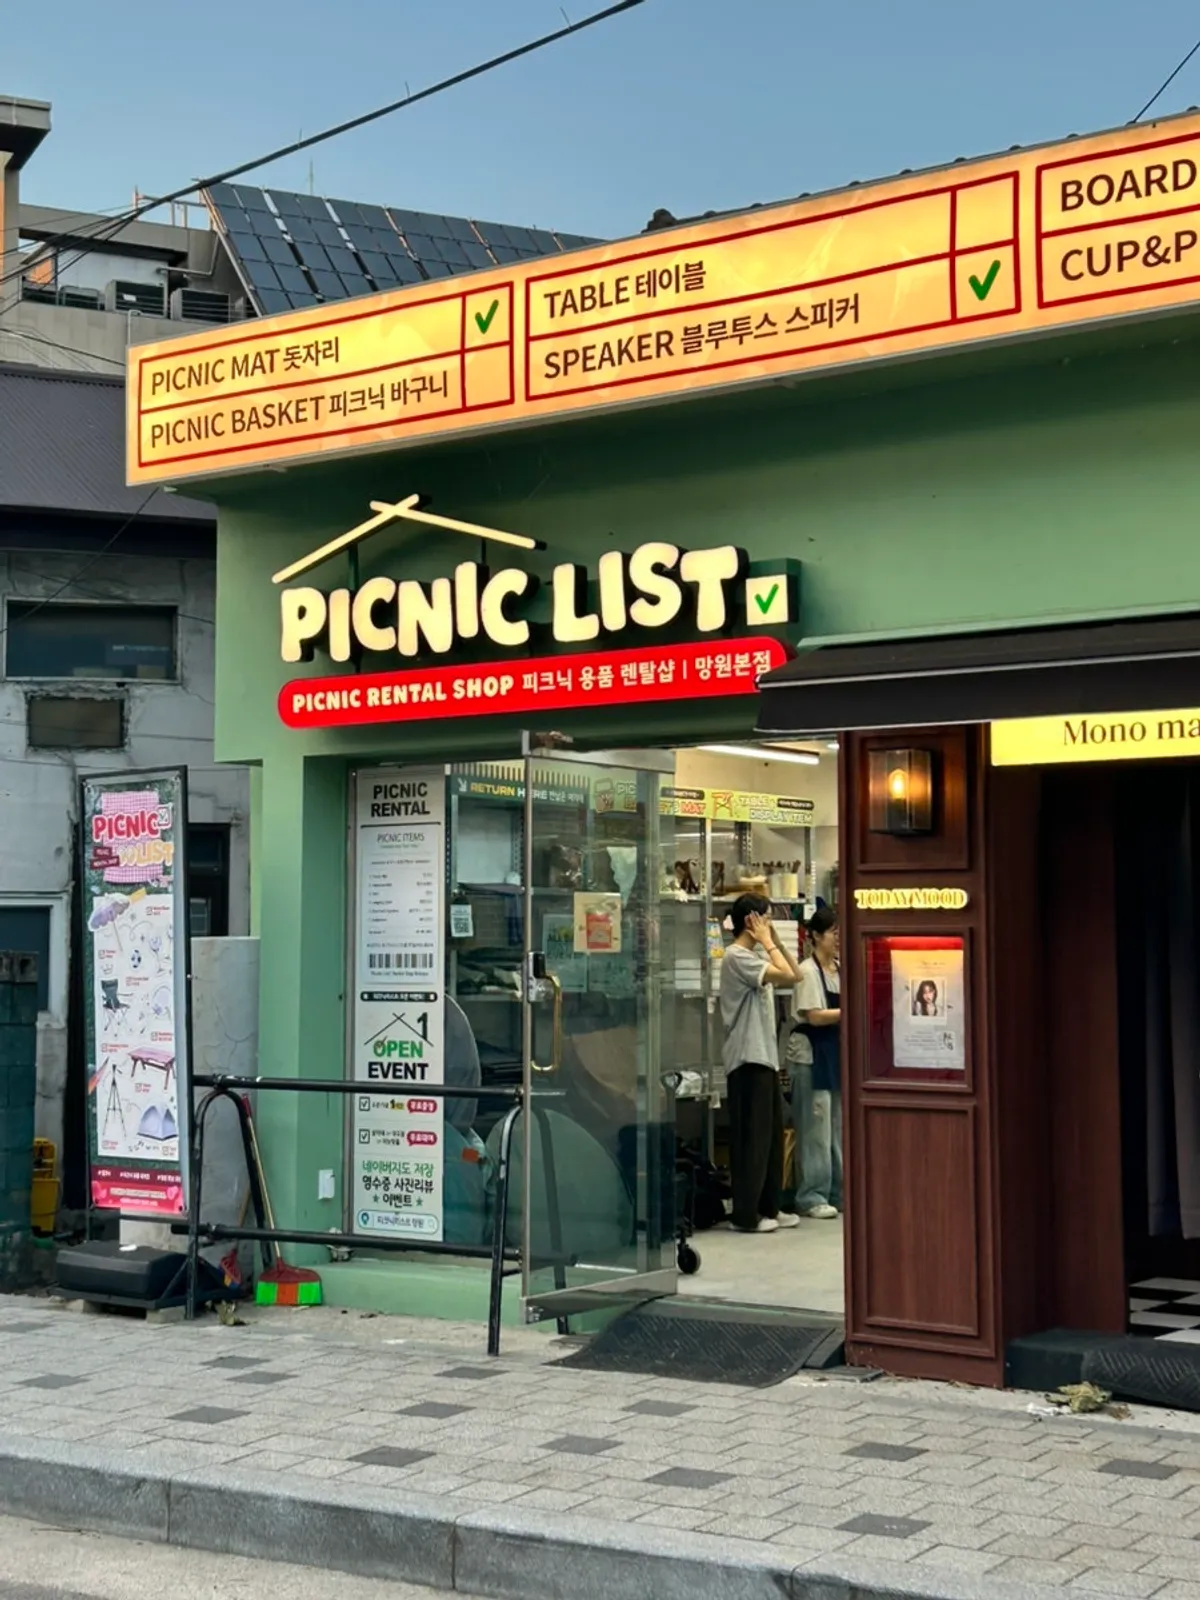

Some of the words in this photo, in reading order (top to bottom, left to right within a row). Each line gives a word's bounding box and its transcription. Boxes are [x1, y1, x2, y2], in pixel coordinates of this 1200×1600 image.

[1061, 158, 1197, 212] BOARD
[1061, 229, 1198, 281] CUP&P
[544, 275, 630, 319] TABLE
[635, 260, 707, 298] 테이블
[544, 329, 675, 379] SPEAKER
[681, 311, 778, 355] 블루투스
[784, 293, 860, 334] 스피커
[151, 359, 225, 396] PICNIC
[231, 349, 281, 380] MAT
[282, 336, 340, 369] 돗자리
[151, 411, 225, 448] PICNIC
[232, 395, 325, 435] BASKET
[329, 382, 386, 417] 피크닉
[390, 370, 448, 406] 바구니
[281, 560, 531, 662] PICNIC
[552, 541, 739, 643] LIST
[292, 687, 362, 713] PICNIC
[366, 682, 448, 707] RENTAL
[452, 674, 514, 700] SHOP
[522, 668, 573, 694] 피크닉
[578, 665, 615, 691] 용품
[620, 659, 676, 686] 렌탈샵
[695, 650, 772, 681] 망원본점
[1064, 719, 1147, 746] Mono
[1158, 718, 1200, 740] ma
[373, 782, 428, 799] PICNIC
[470, 782, 516, 797] RETURN
[517, 787, 548, 801] HRE
[371, 801, 431, 818] RENTAL
[93, 810, 160, 841] PICNIC
[373, 1038, 424, 1058] OPEN
[368, 1061, 430, 1081] EVENT
[362, 1160, 411, 1175] 네이버지도
[414, 1162, 434, 1178] 저장
[394, 1177, 434, 1194] 사진리뷰
[382, 1193, 413, 1209] 이벤트
